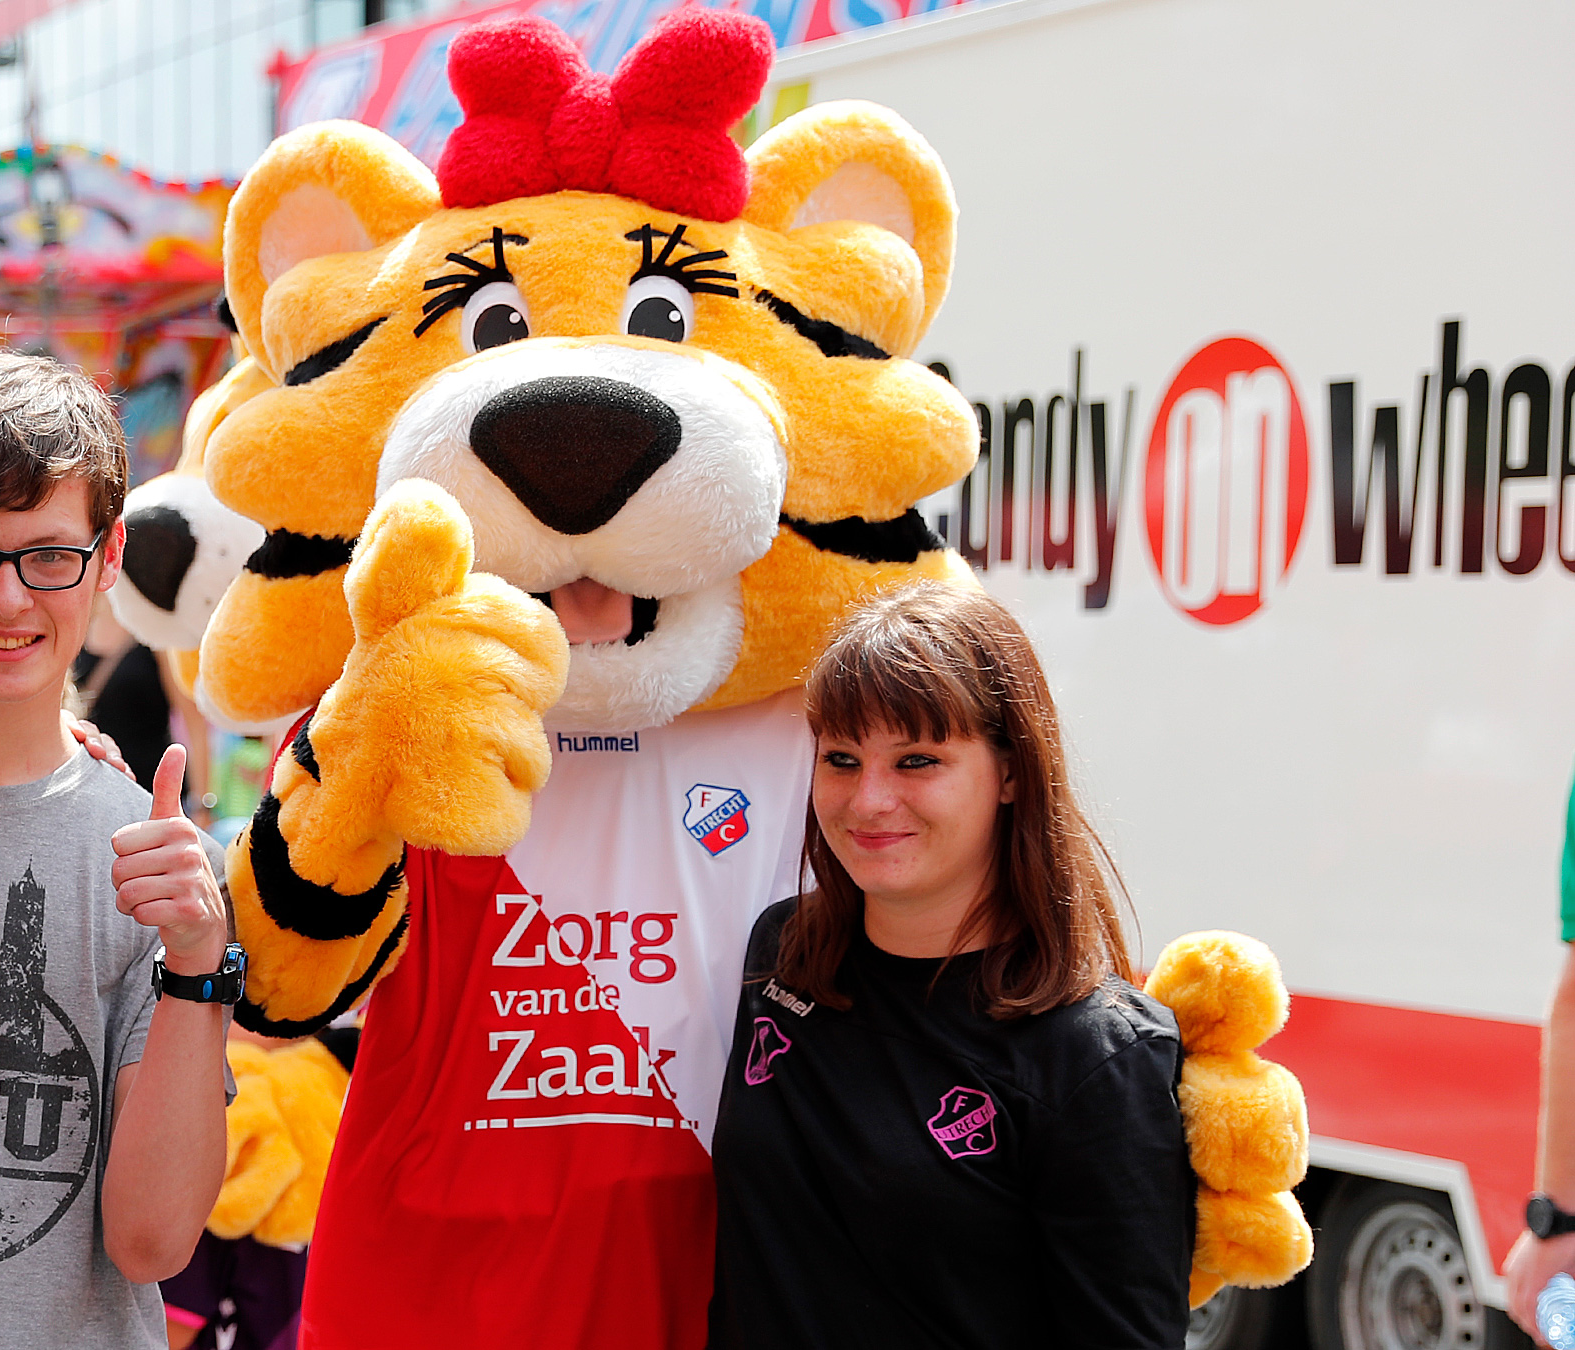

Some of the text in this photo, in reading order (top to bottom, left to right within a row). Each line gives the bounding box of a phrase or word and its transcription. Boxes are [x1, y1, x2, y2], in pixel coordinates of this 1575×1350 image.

[927, 349, 1134, 608] andy
[1163, 366, 1289, 611] on
[557, 731, 639, 752] hummel
[701, 791, 712, 808] F
[690, 794, 746, 839] UTRECHT
[719, 824, 736, 842] C
[491, 894, 678, 984] Zorg
[490, 975, 620, 1017] van de
[487, 1026, 678, 1101] Zaak
[951, 1095, 968, 1113] F
[934, 1107, 991, 1139] UTRECH
[966, 1133, 985, 1150] C
